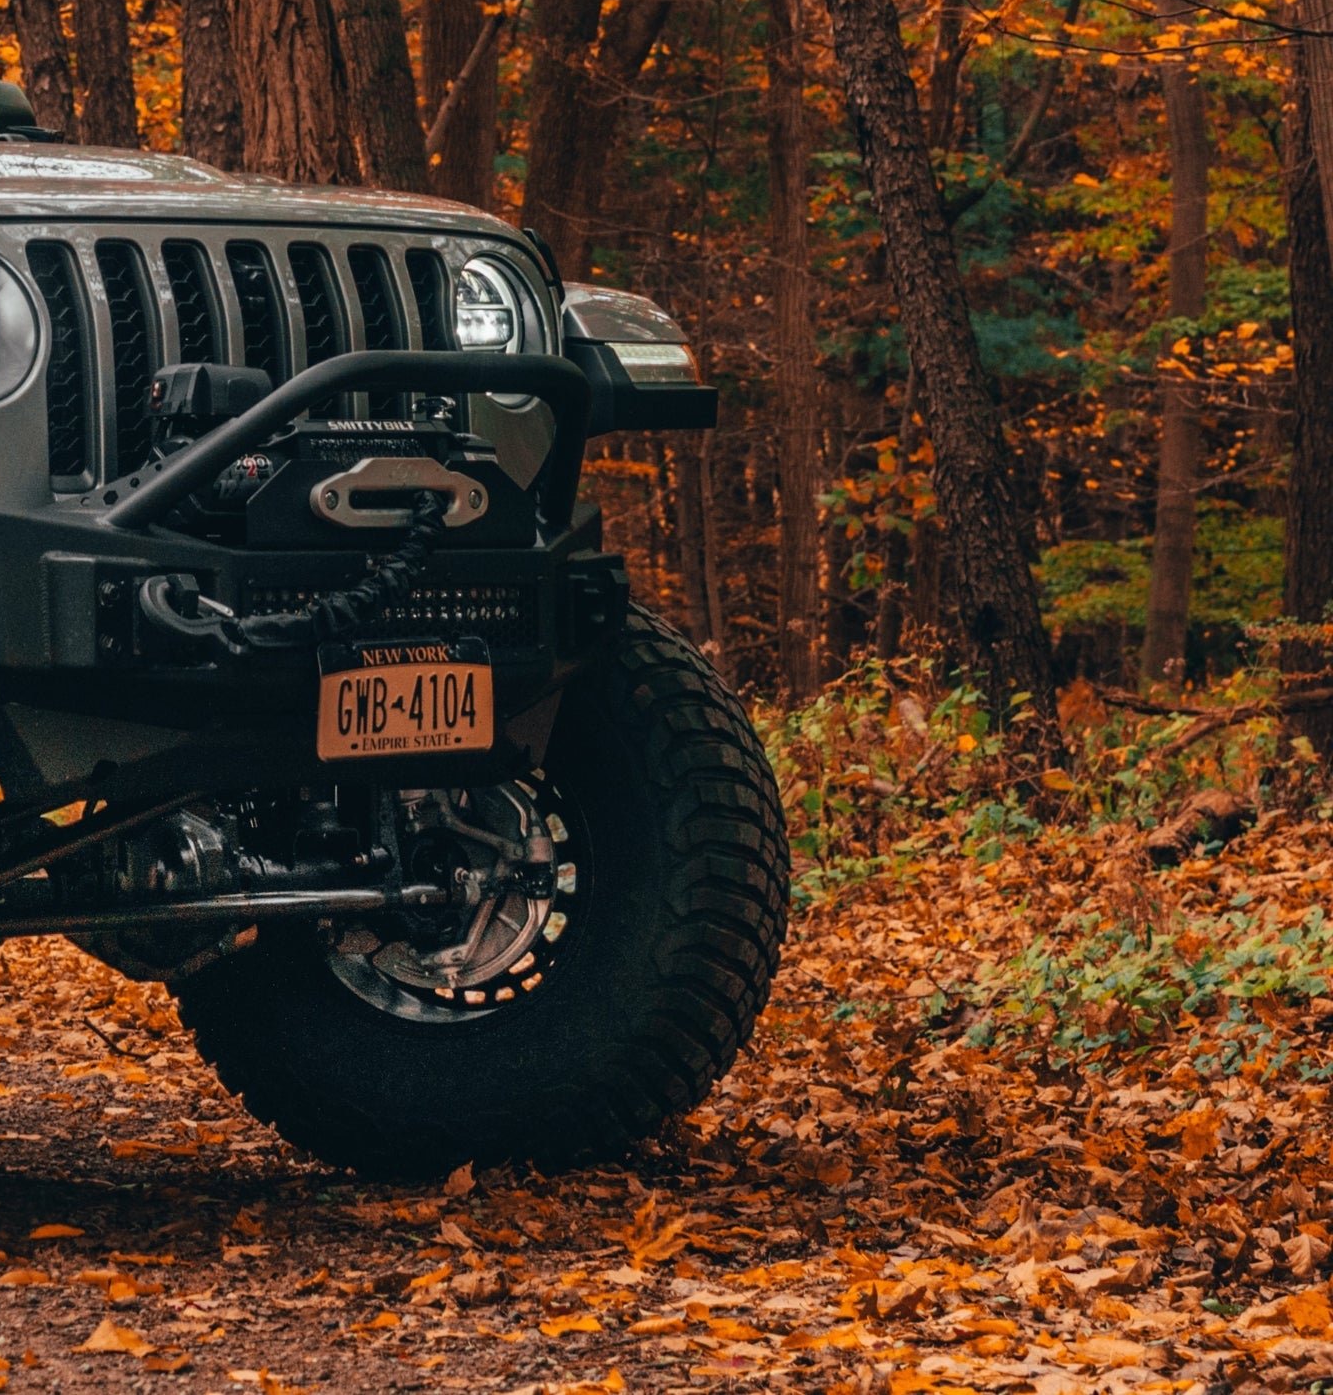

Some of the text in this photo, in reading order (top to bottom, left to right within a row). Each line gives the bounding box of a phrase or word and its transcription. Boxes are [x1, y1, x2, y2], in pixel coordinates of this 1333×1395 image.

[328, 420, 416, 431] SMITTYBILT
[362, 645, 450, 666] NEW YORK
[362, 733, 451, 751] EMPIRE STATE
